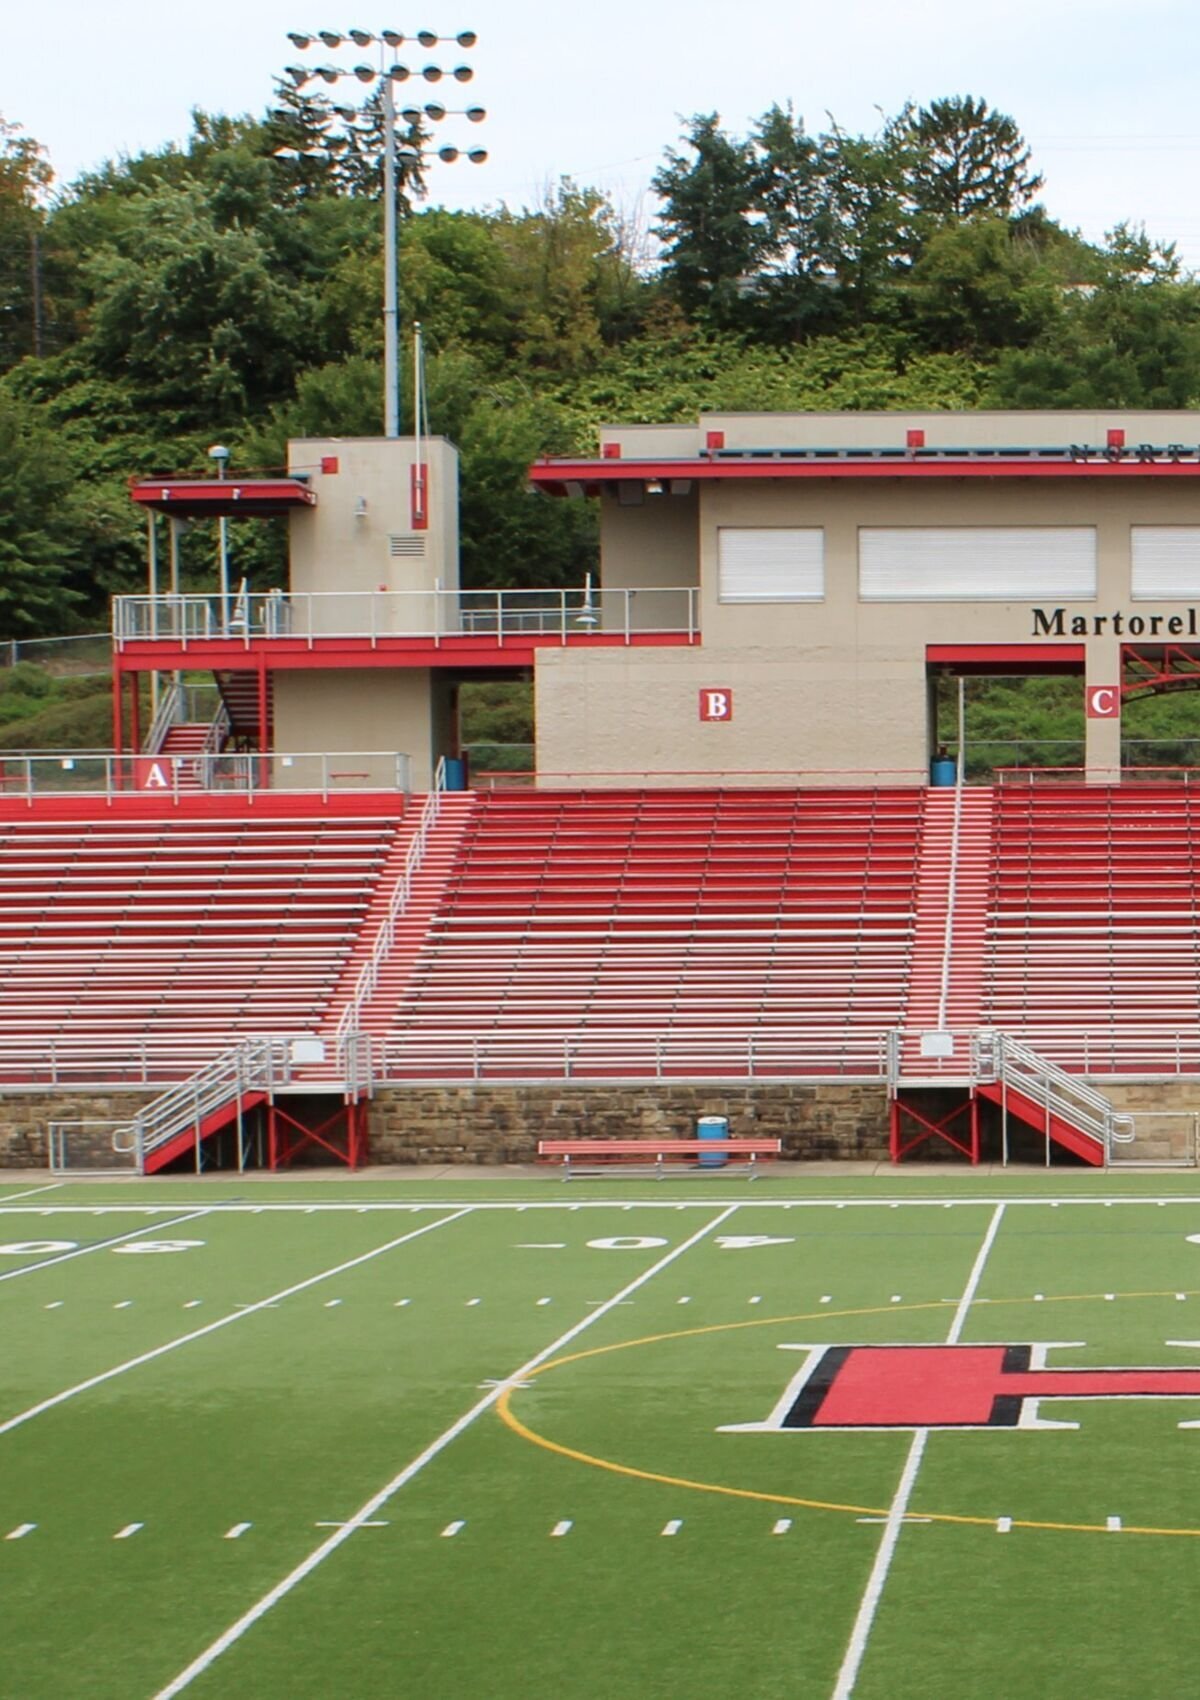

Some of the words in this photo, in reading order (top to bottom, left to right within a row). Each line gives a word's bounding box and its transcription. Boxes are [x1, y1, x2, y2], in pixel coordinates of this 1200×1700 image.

[705, 692, 728, 717] B
[1091, 690, 1114, 714] C
[144, 762, 168, 788] A
